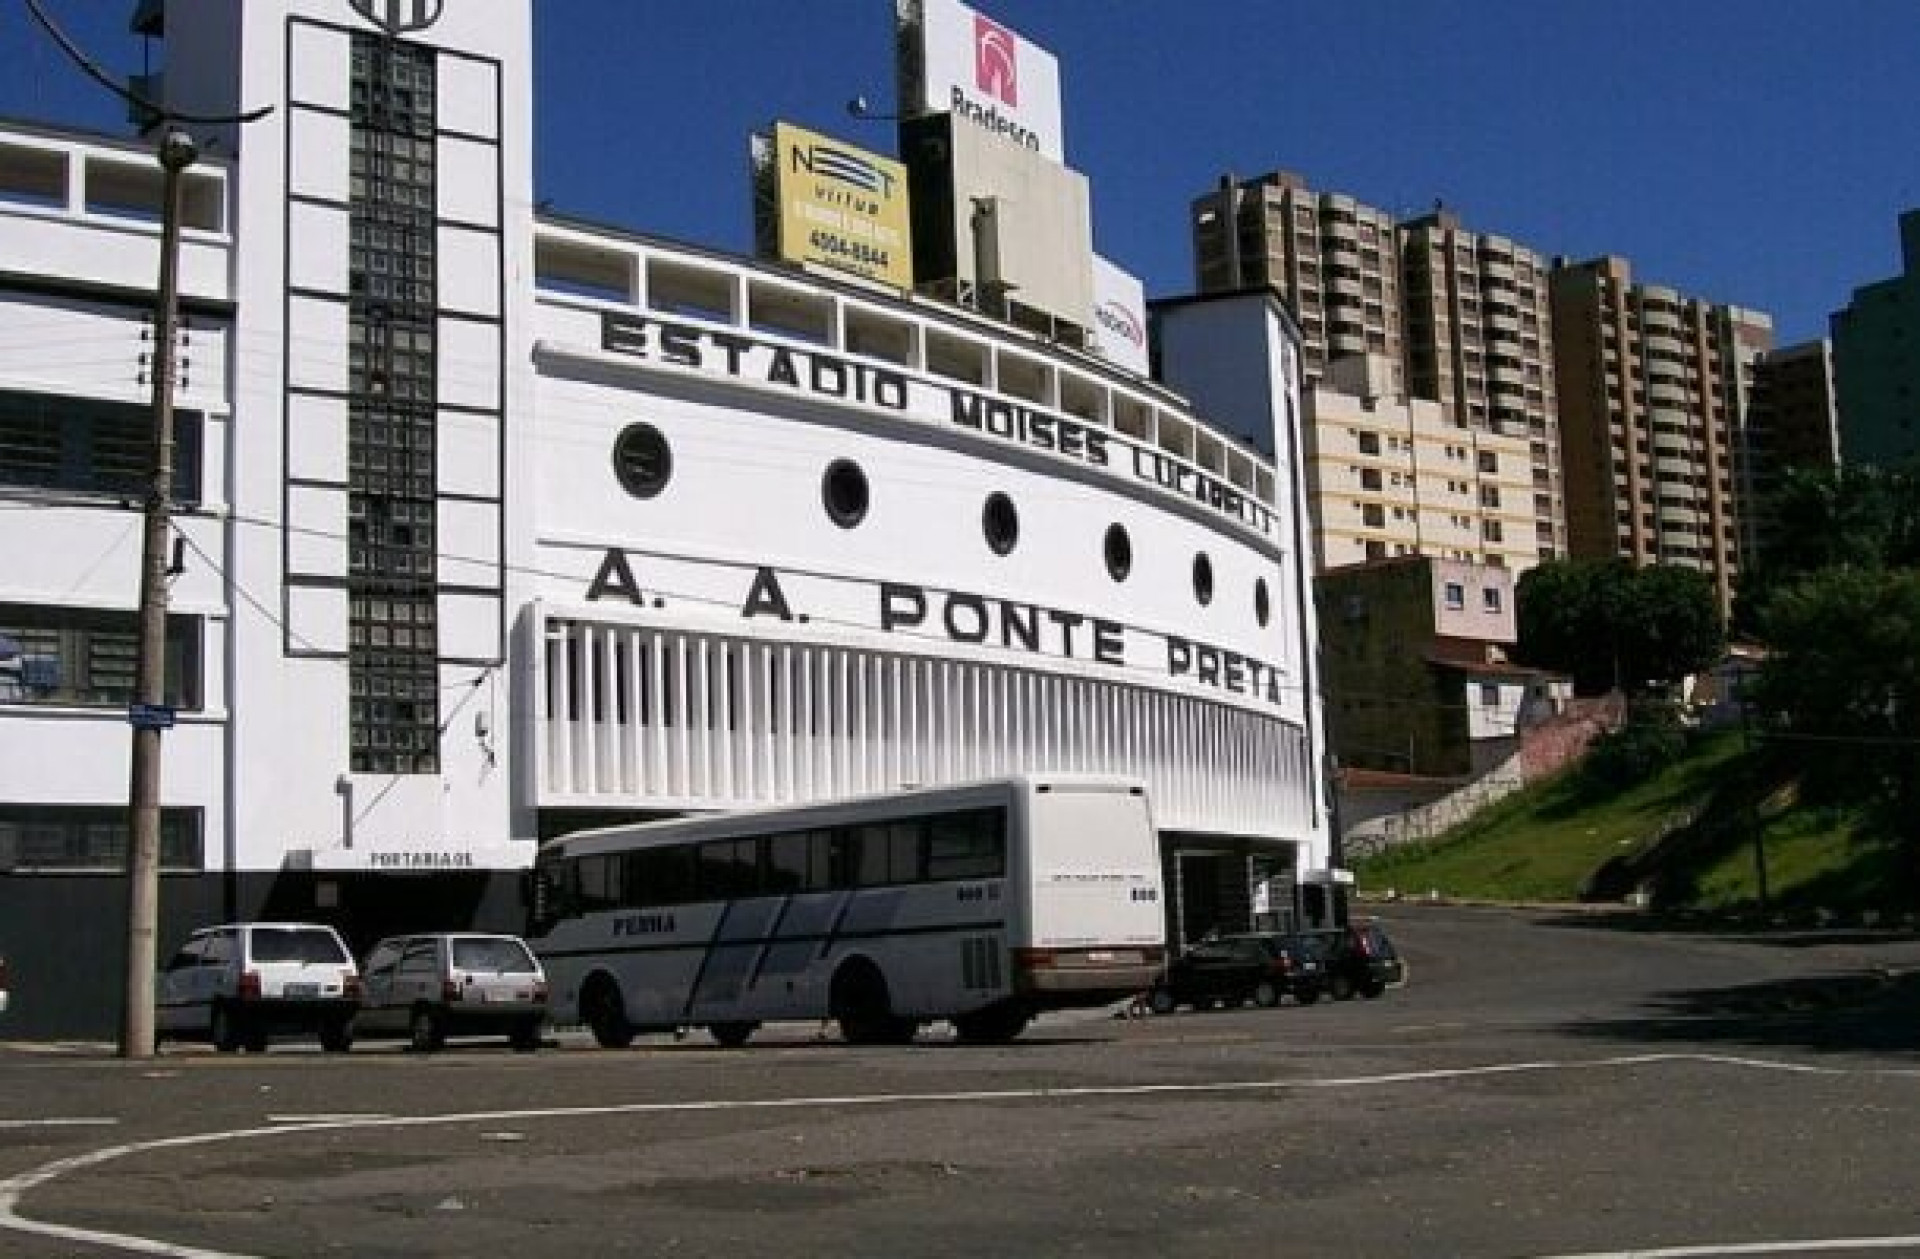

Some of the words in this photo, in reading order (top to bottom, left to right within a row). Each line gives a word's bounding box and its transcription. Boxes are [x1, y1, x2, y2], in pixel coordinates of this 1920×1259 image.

[950, 387, 1109, 466] MOISES
[585, 547, 665, 608] A.
[742, 566, 810, 623] A.
[880, 582, 1125, 666] PONTE
[1167, 635, 1282, 705] PRETA
